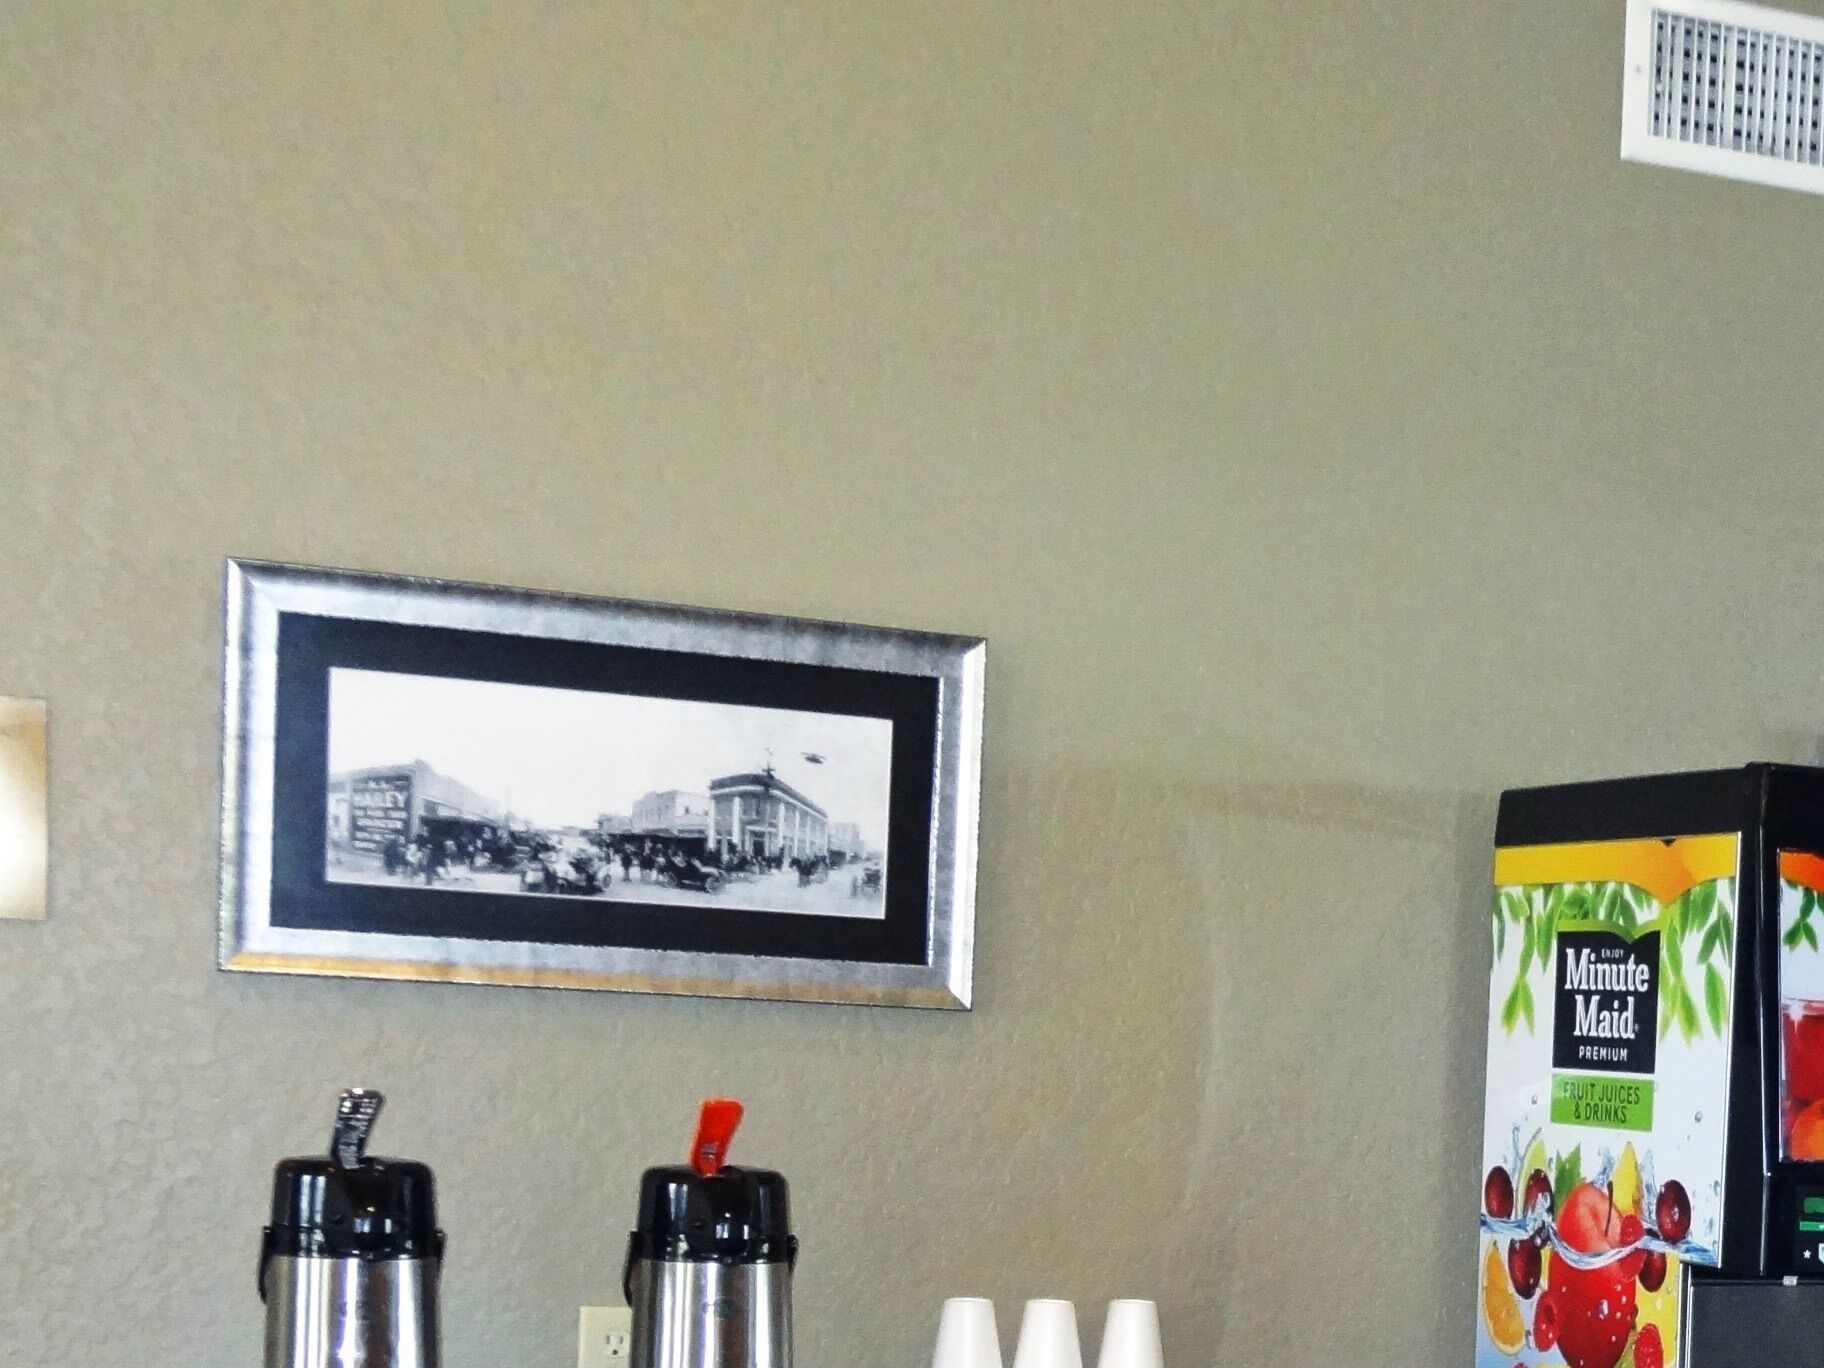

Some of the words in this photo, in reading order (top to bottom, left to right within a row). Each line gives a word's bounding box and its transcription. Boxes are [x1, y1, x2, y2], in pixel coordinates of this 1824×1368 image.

[1601, 948, 1624, 959] ENJOY
[1564, 948, 1650, 992] Minute
[1573, 994, 1636, 1039] Maid
[1578, 1046, 1628, 1061] PREMIUM
[1563, 1081, 1596, 1101] FRUIT
[1598, 1085, 1640, 1105] JUICES
[1574, 1101, 1581, 1119] &
[1584, 1103, 1627, 1124] DRINKS
